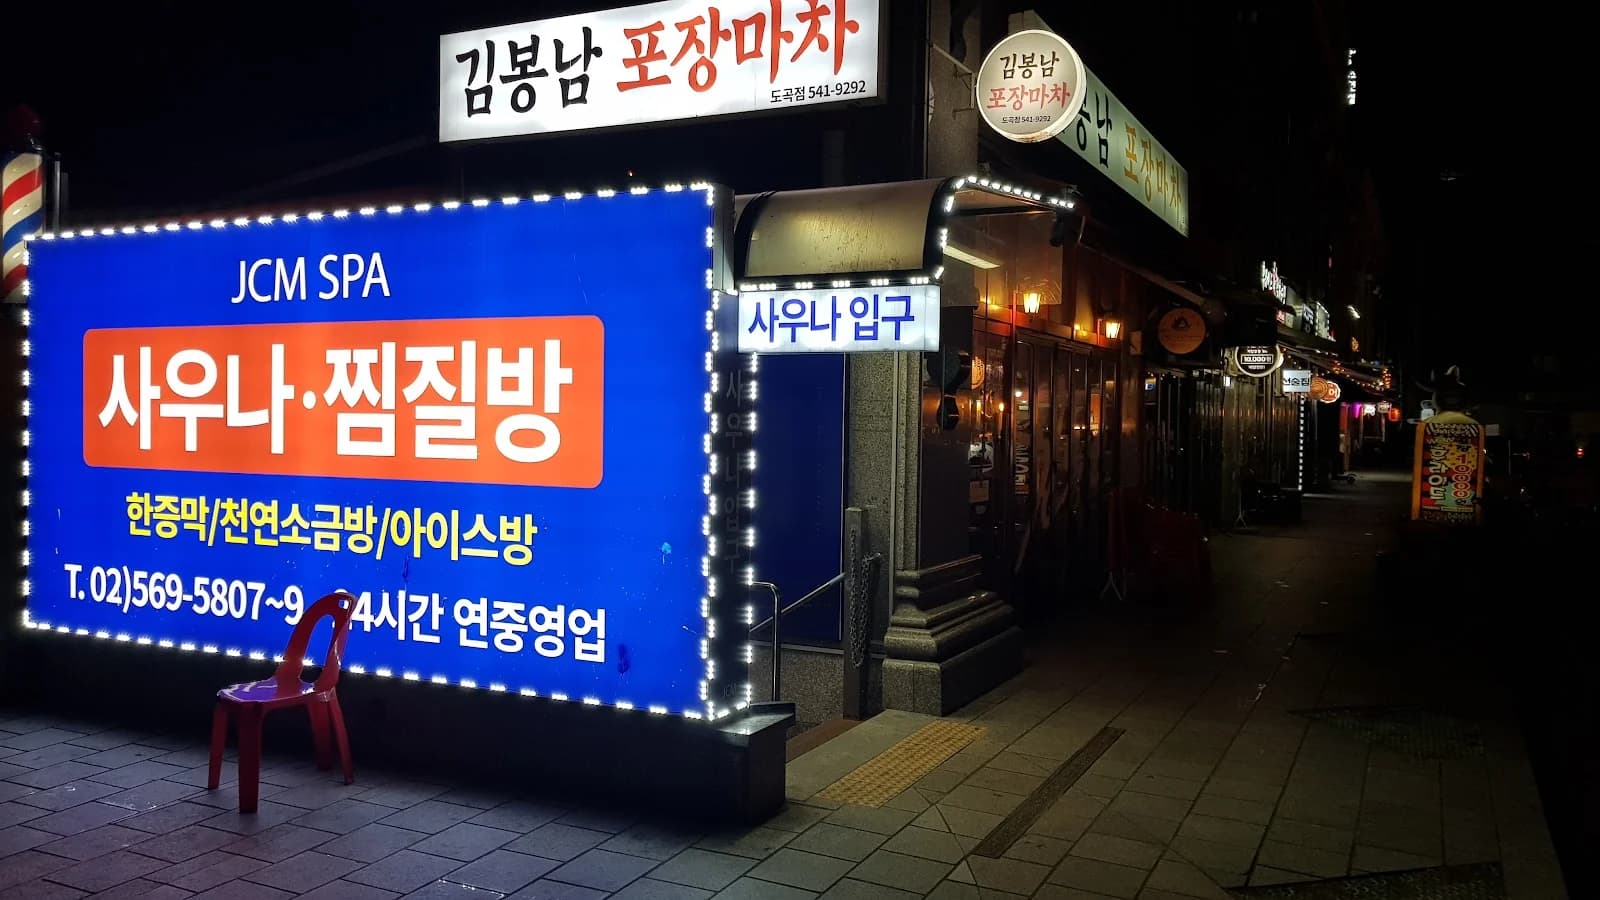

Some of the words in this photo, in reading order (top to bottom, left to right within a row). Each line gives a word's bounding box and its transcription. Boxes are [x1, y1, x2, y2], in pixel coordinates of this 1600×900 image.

[455, 26, 603, 118] 김봉남
[617, 0, 860, 93] 포장마차
[1000, 51, 1060, 80] 김봉남
[770, 86, 805, 103] 도곡점
[808, 80, 866, 99] 541-9292
[987, 82, 1071, 111] 포장마차
[1021, 115, 1051, 123] 541-9292
[1124, 122, 1182, 228] 포장마차
[231, 256, 308, 305] JCM
[318, 252, 391, 300] SPA
[749, 295, 841, 342] 사우나
[850, 294, 915, 341] 입구
[126, 491, 537, 567] 한증막/천연소금방/아이스방
[64, 563, 86, 600] T.
[90, 565, 305, 626] 02)569-5807~9
[453, 597, 607, 663] 연중영업
